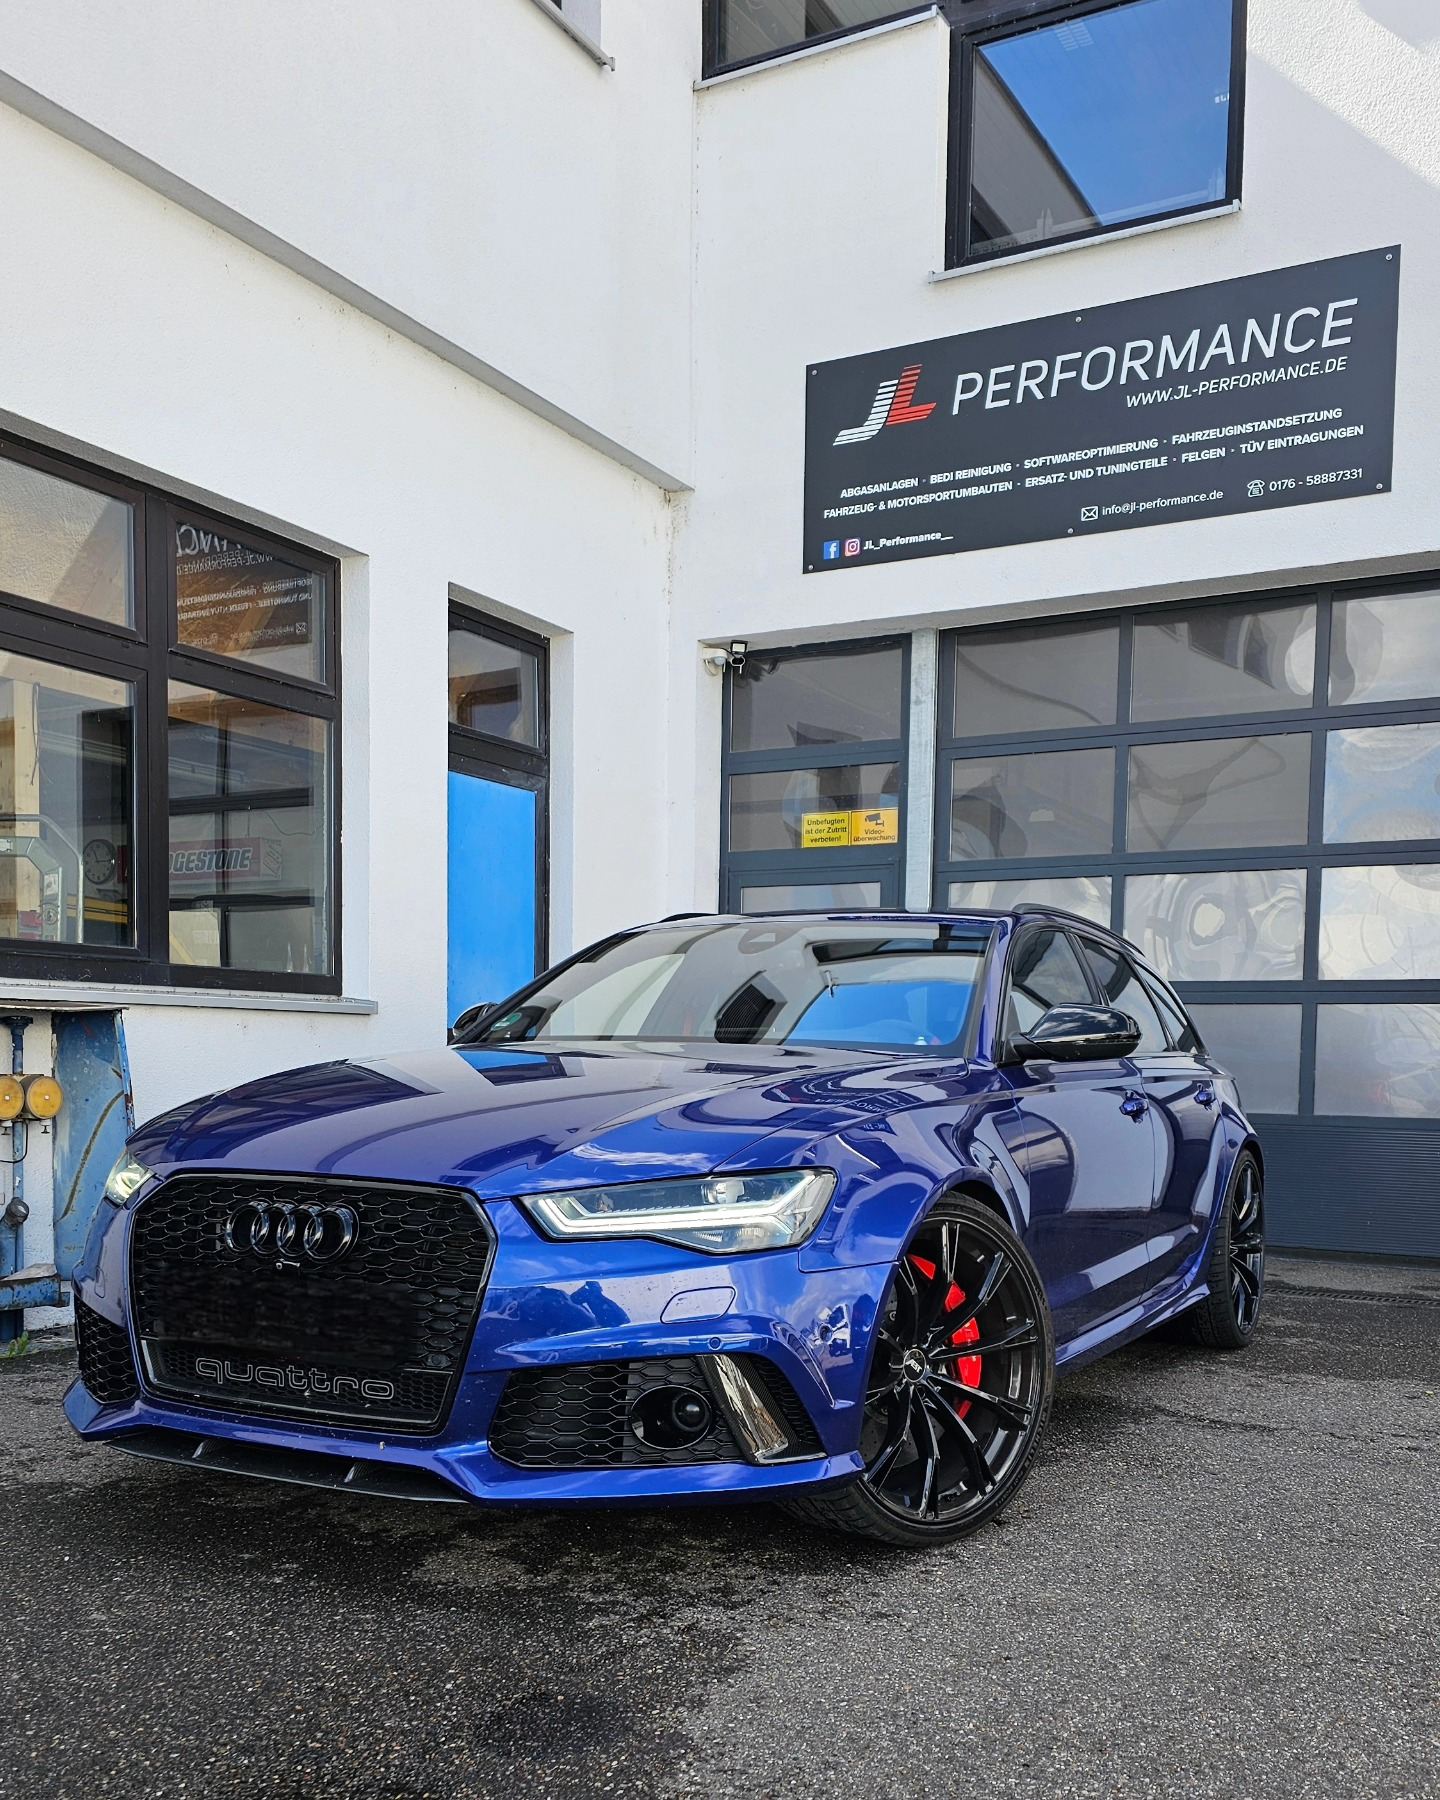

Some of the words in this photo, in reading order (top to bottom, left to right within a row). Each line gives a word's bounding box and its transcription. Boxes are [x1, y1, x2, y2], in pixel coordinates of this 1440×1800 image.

[833, 363, 937, 446] JL
[952, 297, 1358, 416] PERFORMANCE
[1126, 356, 1347, 408] WWW.JL-PERFORMANCE.DE
[840, 477, 918, 498] ABGASANLAGEN
[930, 472, 953, 484] BEDI
[955, 462, 1012, 480] REINIGUNG
[1024, 438, 1159, 469] SOFTWAREOPTIMIERUNG
[1172, 407, 1343, 445] FAHRZEUGINSTANDSETZUNG
[823, 502, 878, 519] FAHRZEUG-
[878, 501, 886, 511] &
[887, 480, 1013, 509] MOTORSPORTUMBAUTEN
[1025, 472, 1067, 488] ERSATZ-
[1069, 468, 1094, 481] UND
[1096, 456, 1168, 477] TUNINGTEILE
[1181, 446, 1226, 463] FELGEN
[1240, 439, 1265, 454] TÜV
[1267, 424, 1364, 450] EINTRAGUNGEN
[1269, 478, 1296, 491] 0176
[1306, 468, 1363, 486] 58887331
[1102, 489, 1223, 516] info@jl-performance.de
[807, 818, 845, 826] Unbefugten
[810, 835, 841, 843] verboten!
[169, 848, 253, 874] GESTONE
[195, 1357, 395, 1400] quattro
